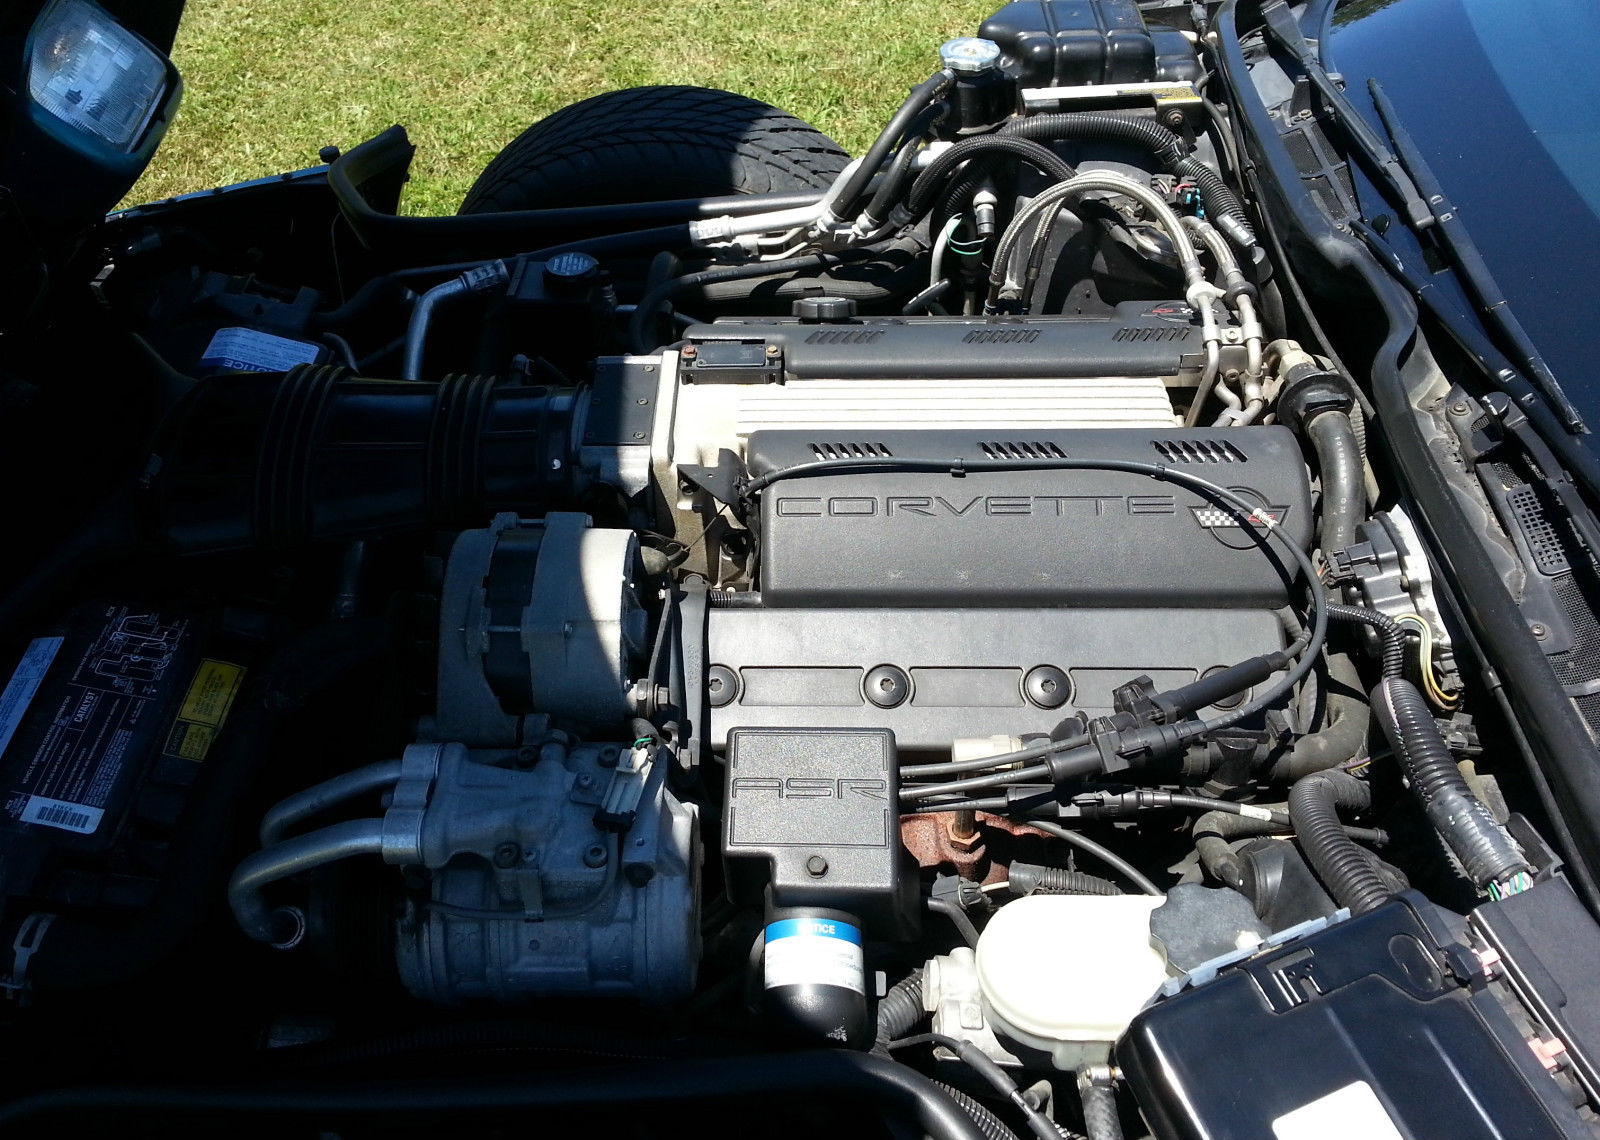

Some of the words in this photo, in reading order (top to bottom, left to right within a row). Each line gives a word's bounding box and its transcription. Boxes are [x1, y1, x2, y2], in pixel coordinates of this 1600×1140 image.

[224, 359, 274, 372] OTICE
[777, 496, 1175, 518] CORVETTE
[74, 692, 97, 722] CATALYST
[731, 777, 888, 800] ASR
[797, 922, 836, 934] TICE
